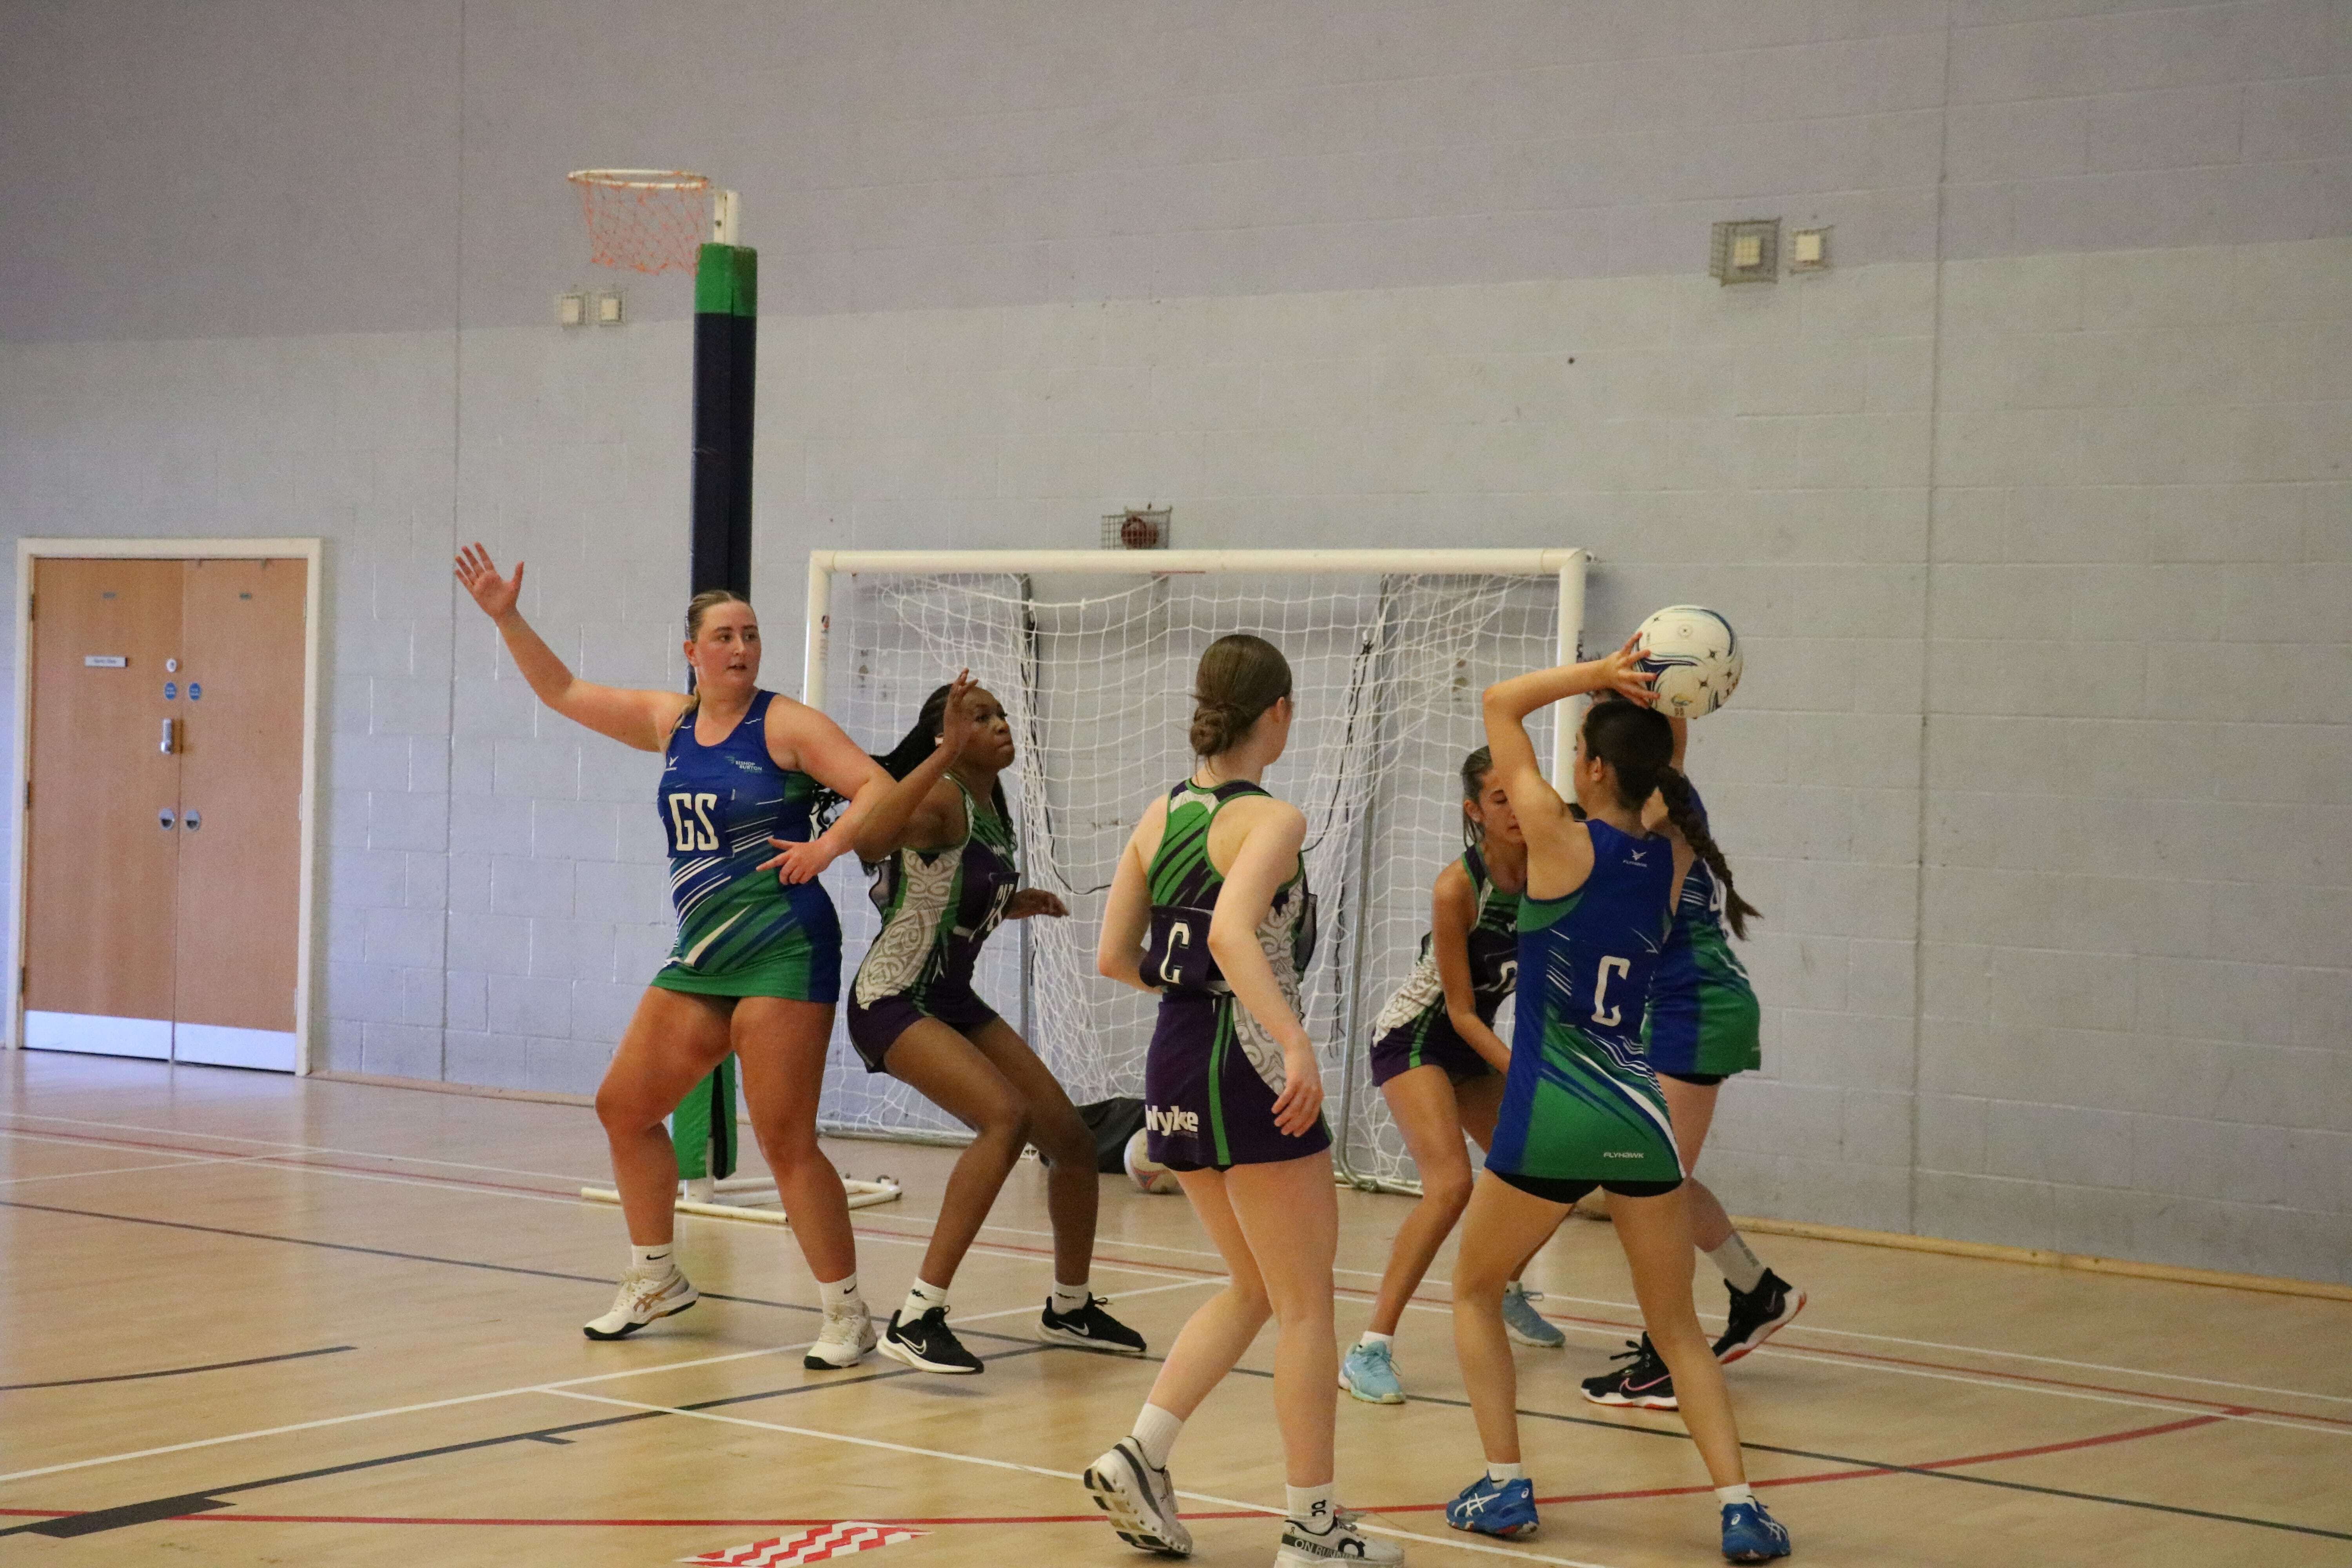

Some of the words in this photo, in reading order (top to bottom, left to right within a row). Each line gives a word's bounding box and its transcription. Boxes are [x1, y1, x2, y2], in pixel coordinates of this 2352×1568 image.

[668, 793, 719, 851] GS
[1160, 922, 1190, 984] C
[1591, 955, 1631, 1027] C
[1145, 1104, 1199, 1136] Wyke
